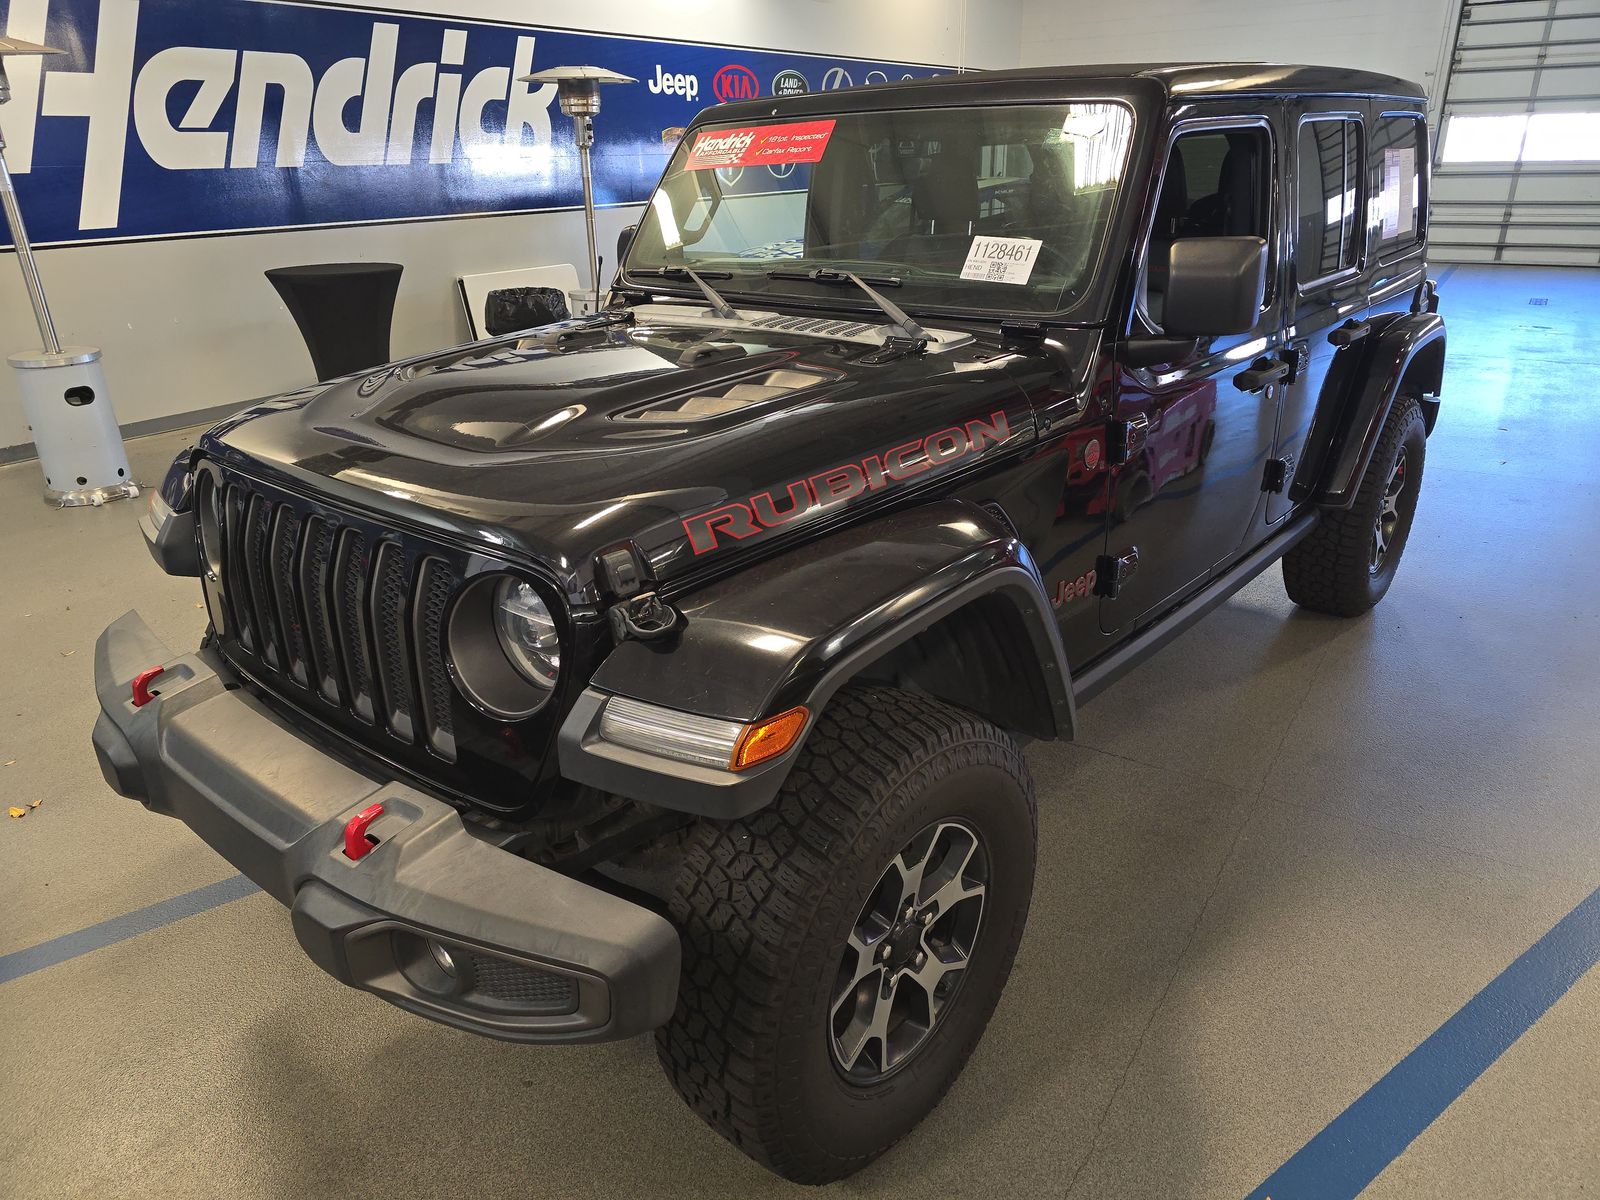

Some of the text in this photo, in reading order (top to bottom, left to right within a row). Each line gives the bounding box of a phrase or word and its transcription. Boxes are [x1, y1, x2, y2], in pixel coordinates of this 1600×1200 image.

[648, 64, 699, 102] Jeep
[721, 74, 754, 99] KIA
[780, 77, 798, 89] LAND
[0, 0, 558, 231] Hendrick
[693, 131, 756, 157] Hendrick
[700, 147, 747, 157] AFFORDABLE
[786, 145, 812, 154] Report
[974, 241, 1032, 262] 1128461
[682, 410, 1011, 555] RUBICON
[1051, 569, 1097, 609] Jeep
